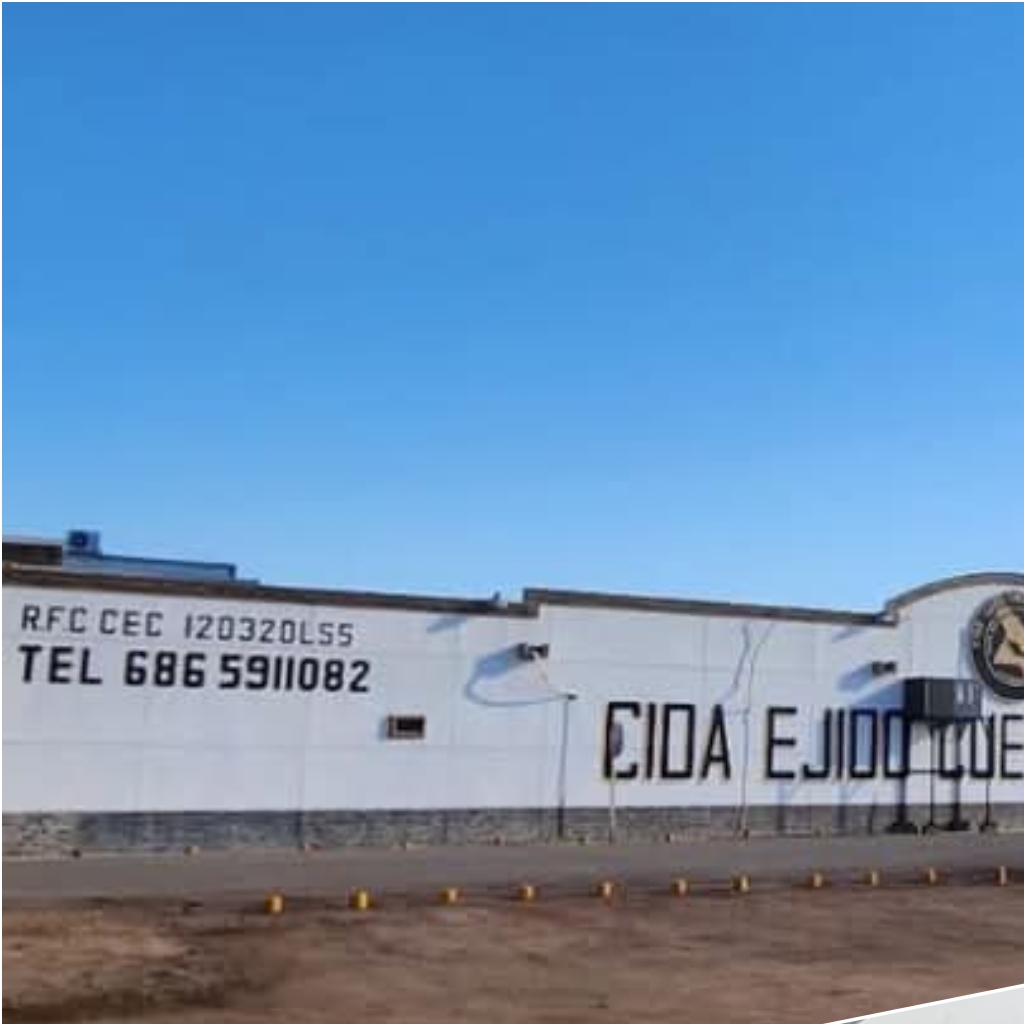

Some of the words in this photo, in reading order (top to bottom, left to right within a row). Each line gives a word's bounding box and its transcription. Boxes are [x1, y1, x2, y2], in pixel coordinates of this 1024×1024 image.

[100, 608, 164, 637] CEC
[18, 645, 103, 685] TEL
[124, 650, 207, 688] 686
[218, 654, 370, 692] 5911082
[603, 700, 731, 779] CIDA
[766, 706, 910, 779] EJIDO
